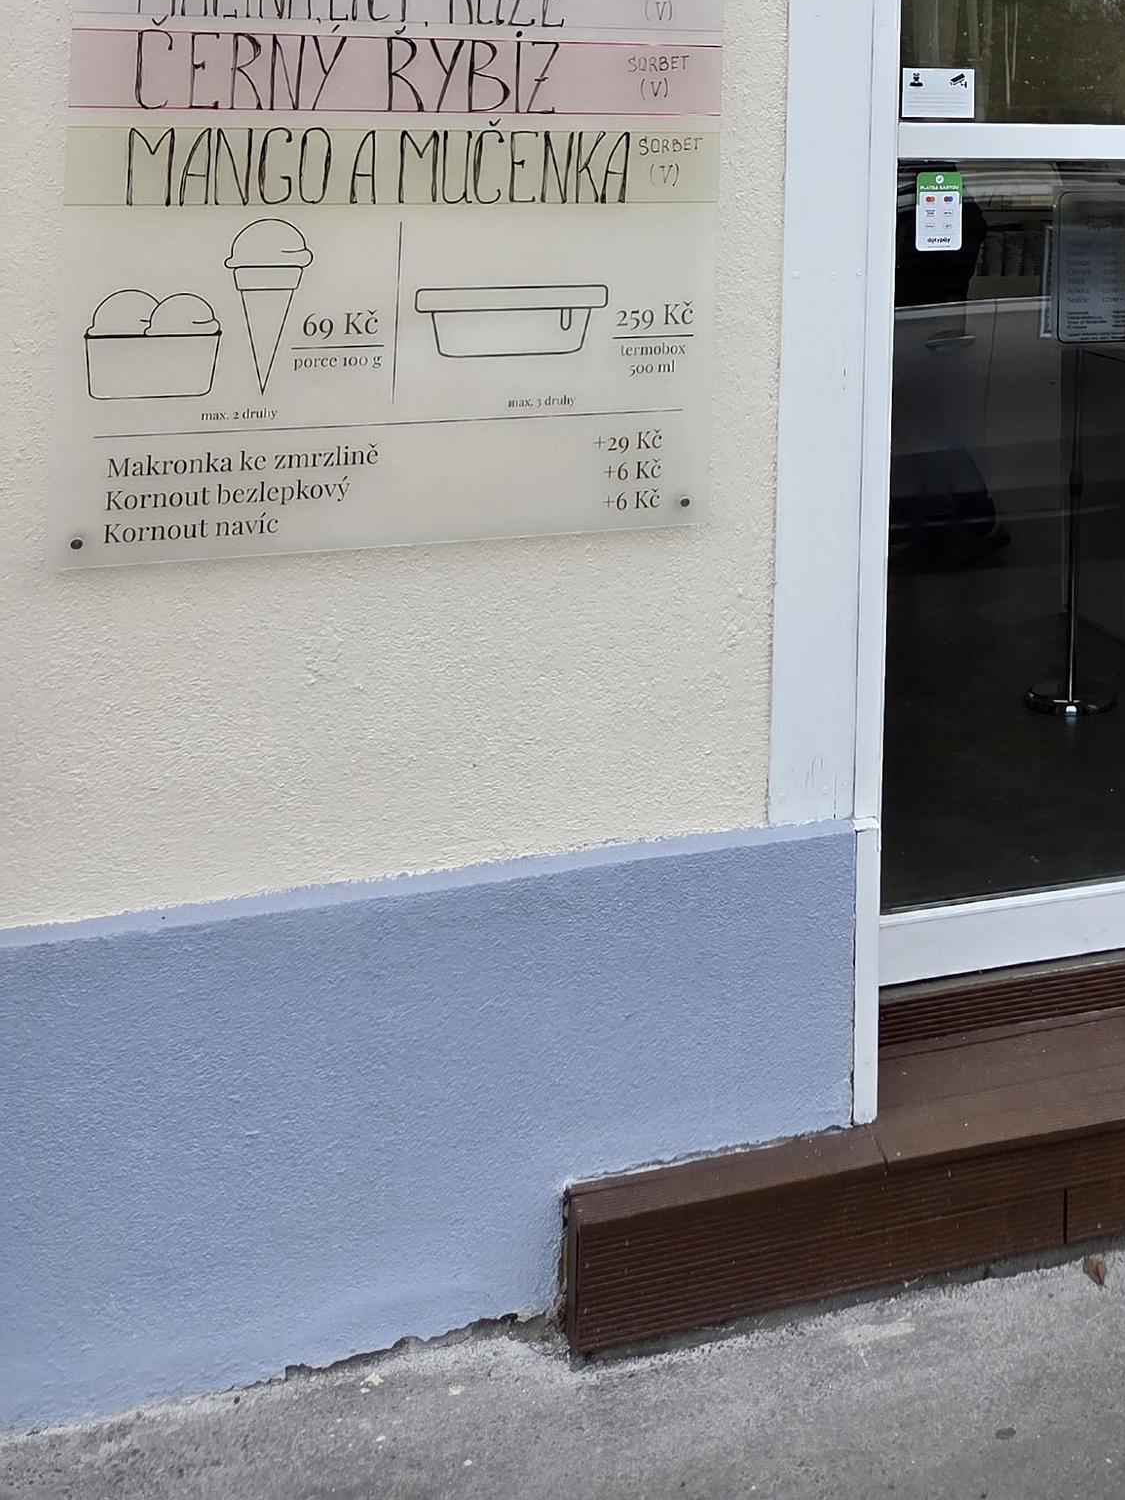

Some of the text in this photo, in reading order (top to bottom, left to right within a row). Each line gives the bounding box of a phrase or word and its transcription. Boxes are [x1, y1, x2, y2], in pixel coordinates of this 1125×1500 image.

[134, 14, 347, 110] ČERNÝ
[627, 55, 689, 72] SORBET
[638, 137, 703, 156] SORBET
[126, 118, 631, 206] MANGO A MUČENKA
[302, 309, 379, 340] 69 Kč
[616, 301, 694, 331] 259 Kč
[620, 341, 686, 357] termobox
[294, 354, 382, 371] porce 100 g
[629, 360, 675, 376] 500 ml
[508, 395, 577, 409] max. 3 druhy
[201, 408, 278, 421] max. 2 druhy
[593, 428, 663, 454] +29 Kč
[106, 443, 379, 478] Makronka ke zmrzlině
[603, 458, 662, 481] +6 Kč
[105, 476, 351, 511] Kornout bezlepkový
[602, 488, 661, 511] +6 Kč
[103, 512, 279, 544] Kornout navíc
